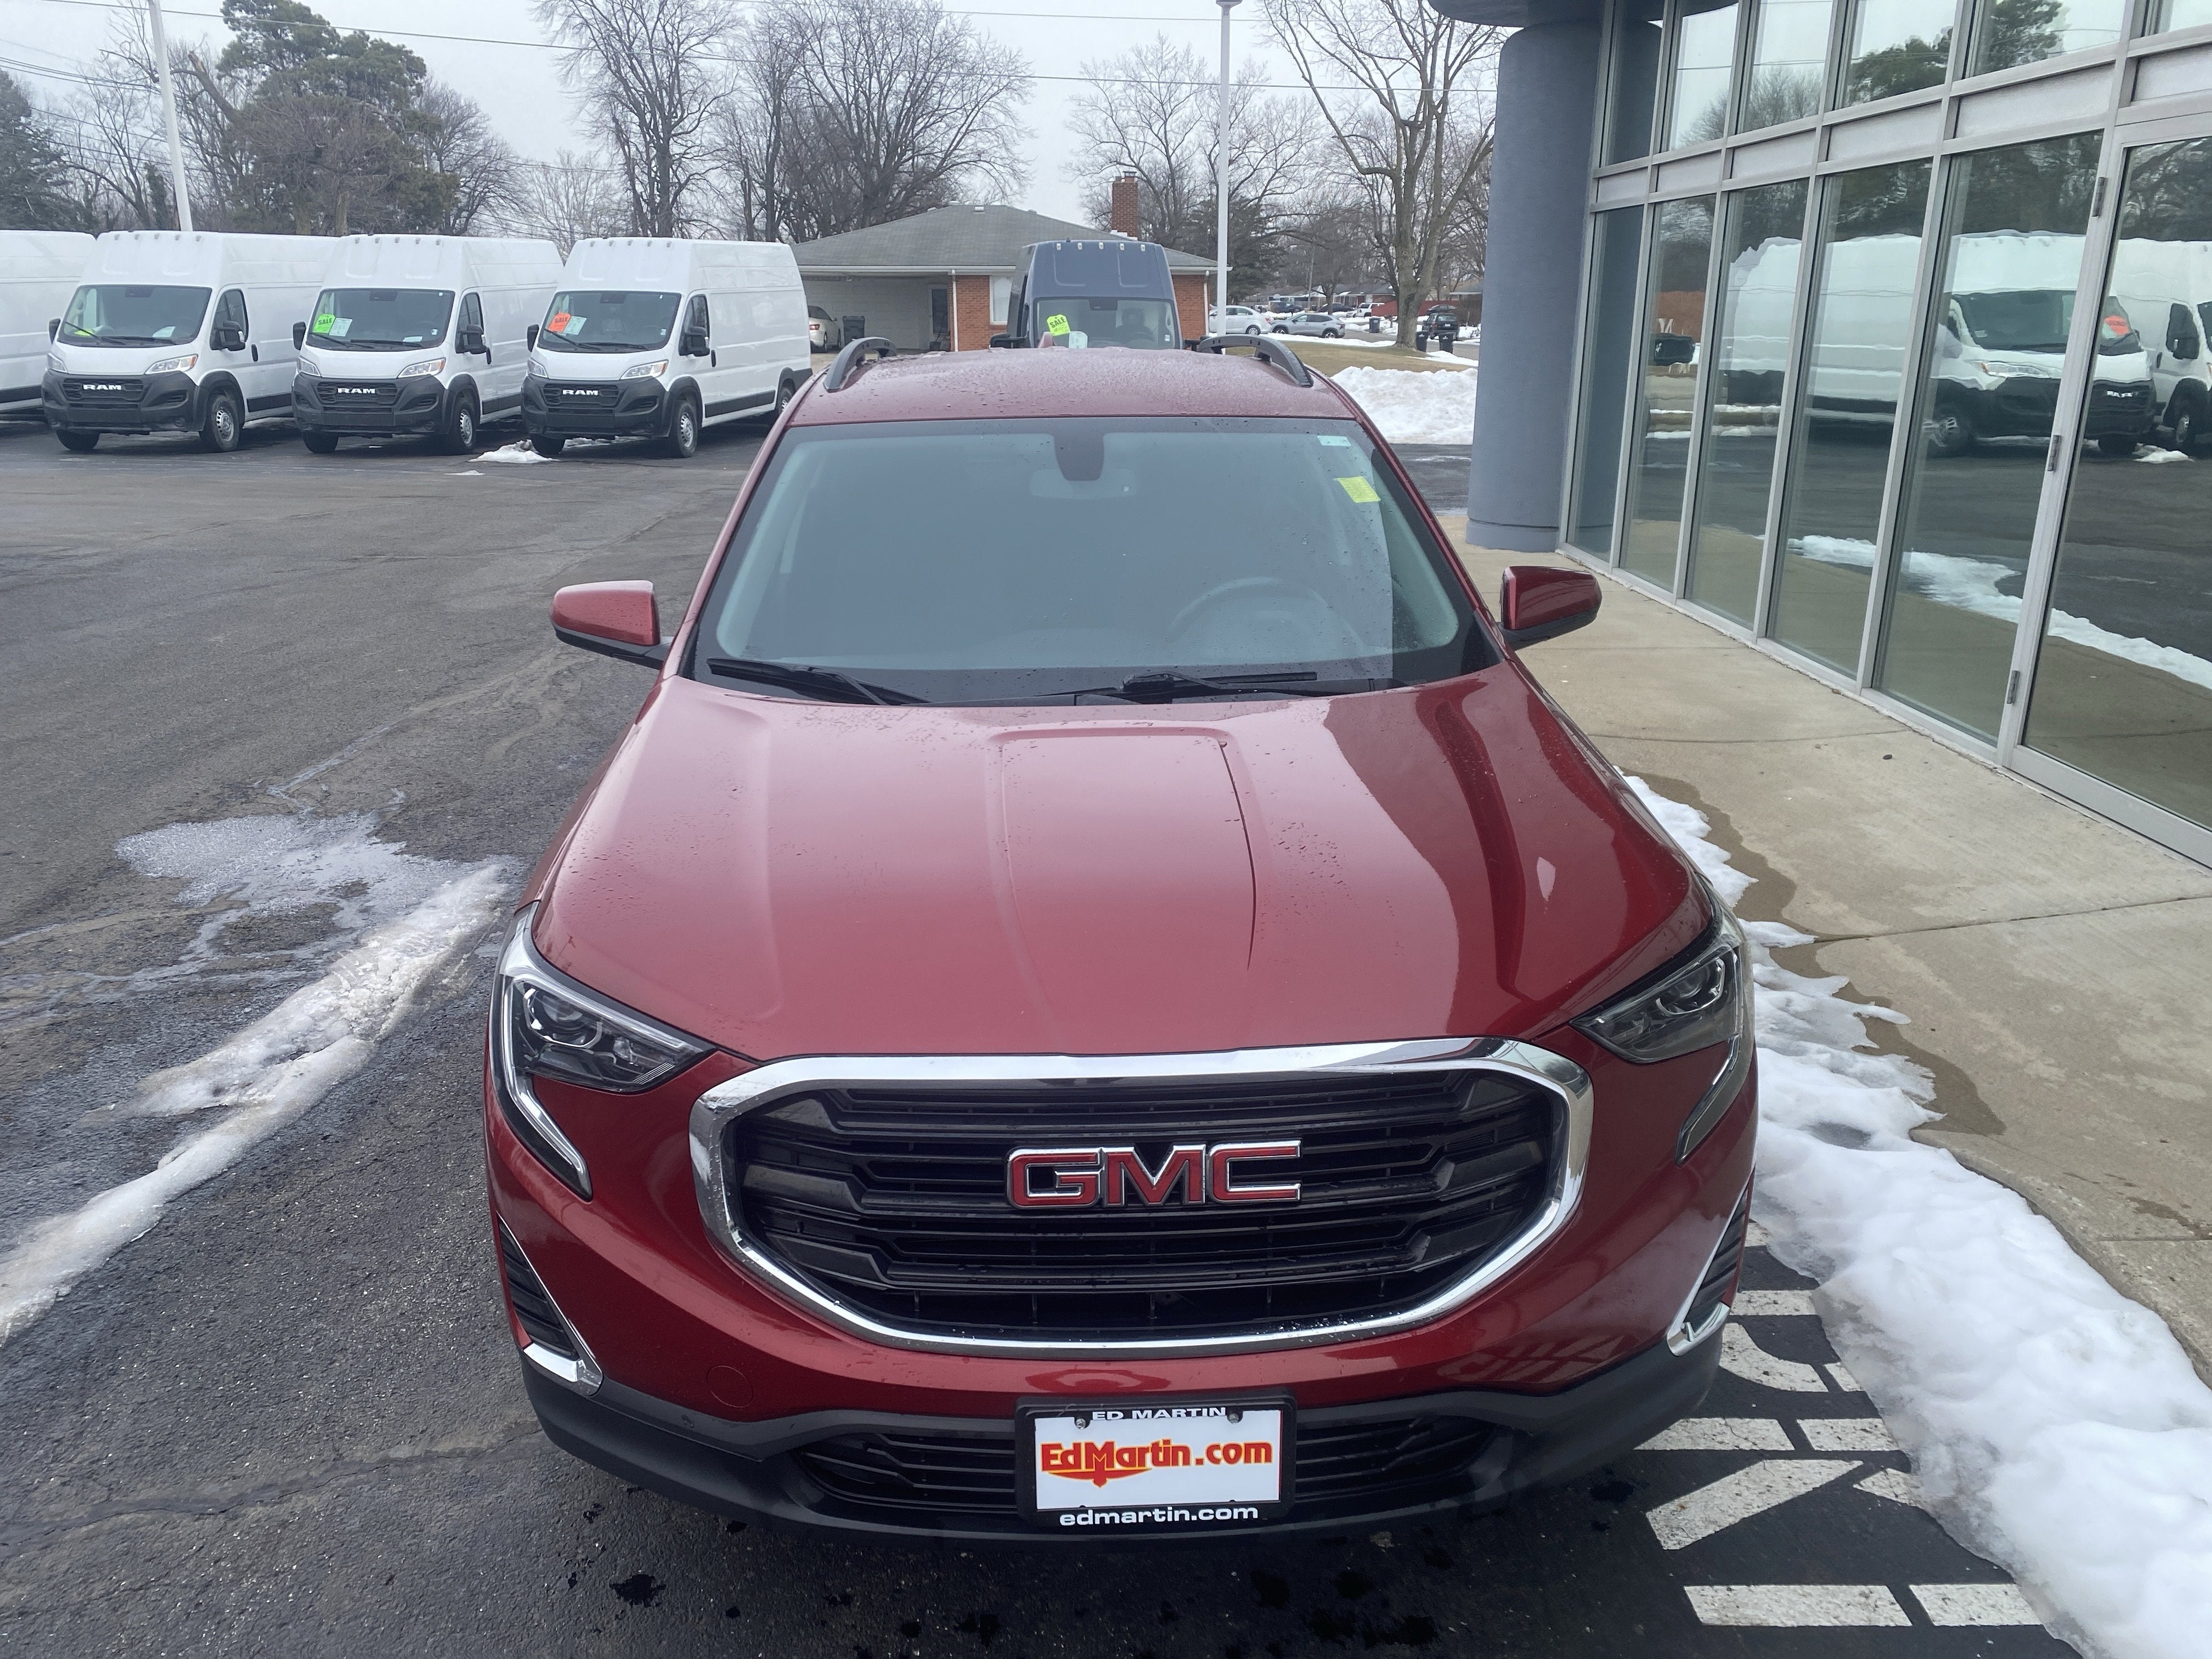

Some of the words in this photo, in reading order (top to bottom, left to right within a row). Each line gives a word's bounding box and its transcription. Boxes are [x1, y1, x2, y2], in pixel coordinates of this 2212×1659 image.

[1049, 317, 1066, 328] SALE
[1007, 1139, 1302, 1207] GMC
[1092, 1411, 1124, 1420] ED
[1132, 1407, 1226, 1420] MARTIN
[1040, 1438, 1273, 1478] EdMartin.com
[1059, 1506, 1259, 1527] edmartin.com
